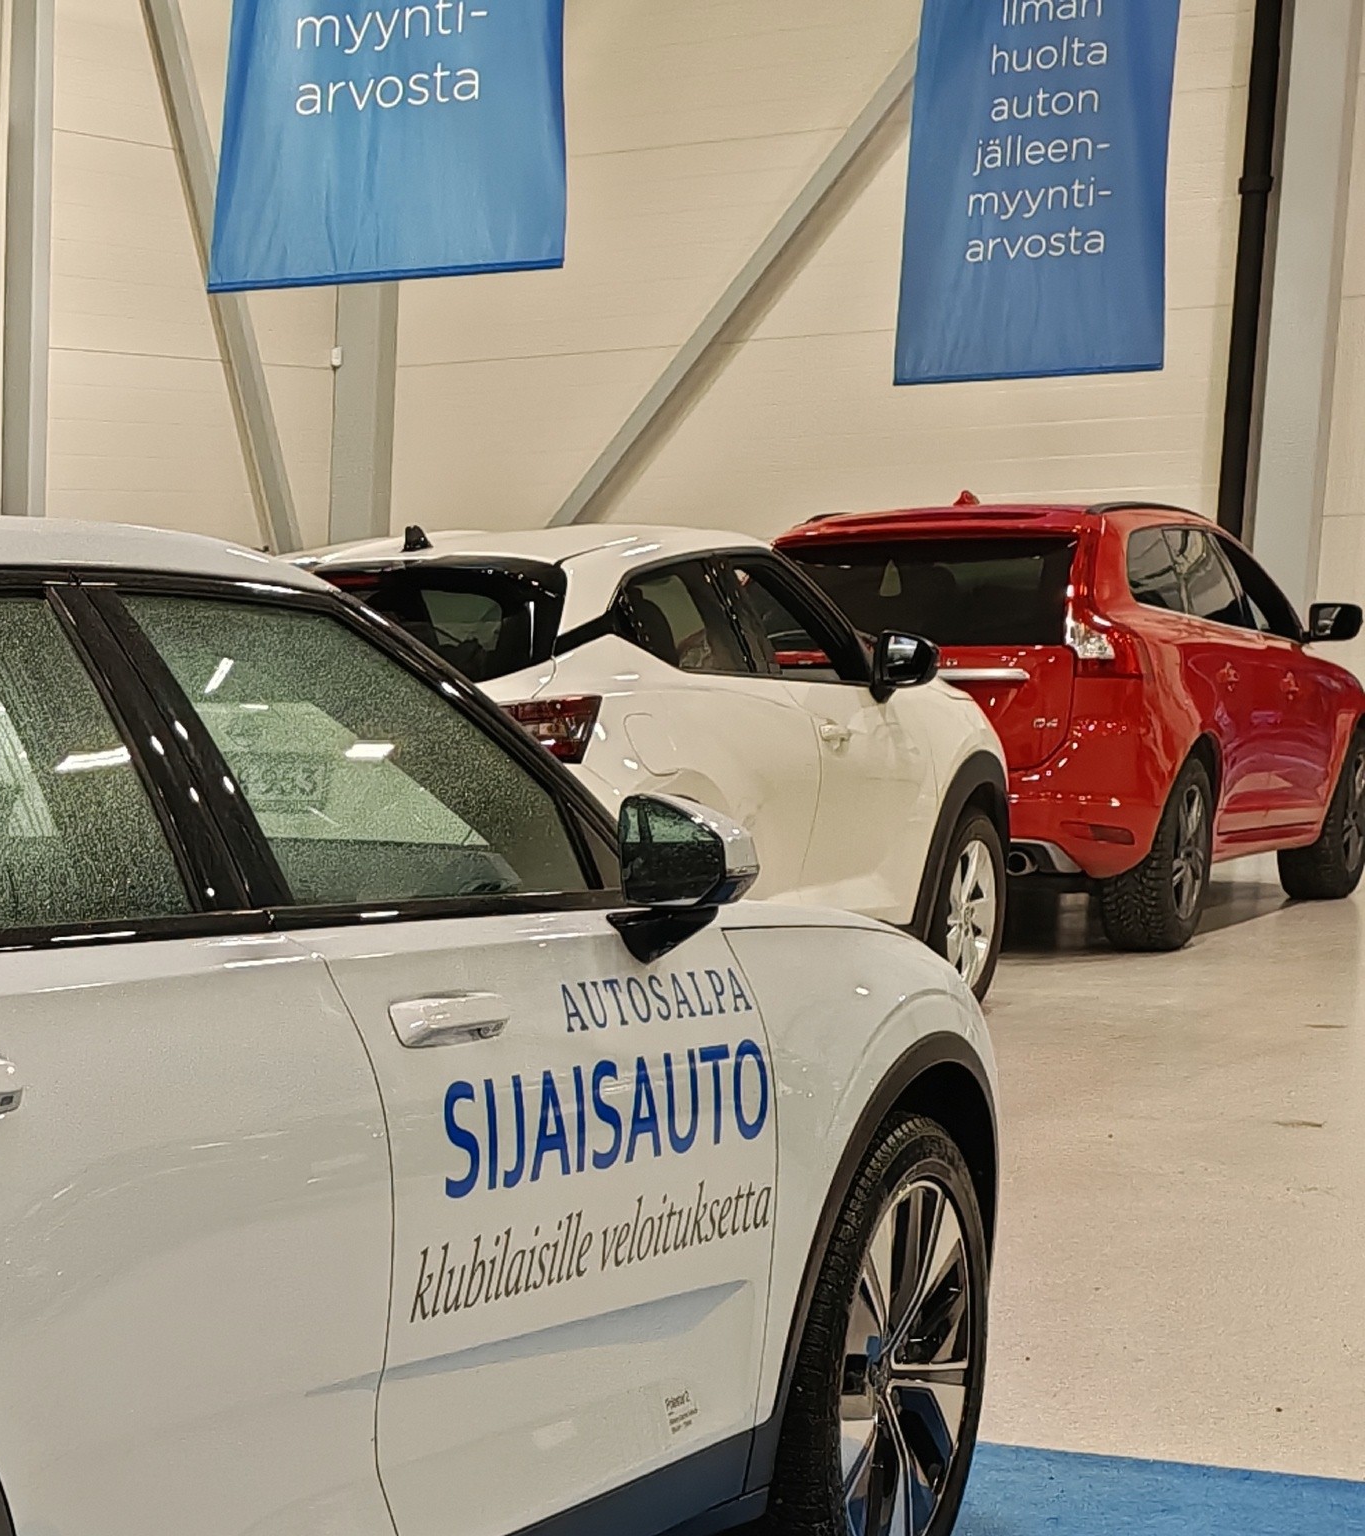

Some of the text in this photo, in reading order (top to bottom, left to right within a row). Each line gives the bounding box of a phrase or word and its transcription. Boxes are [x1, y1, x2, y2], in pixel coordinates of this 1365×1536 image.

[296, 0, 489, 54] myynti-
[1002, 0, 1102, 27] Ilman
[990, 36, 1109, 76] huolta
[295, 62, 481, 116] arvosta
[990, 87, 1100, 122] auton
[972, 135, 1111, 176] jälleen-
[967, 177, 1112, 220] myynti-
[965, 230, 1105, 262] arvosta
[560, 967, 753, 1033] AUTOSALPA
[444, 1038, 769, 1199] SIJAISAUTO
[410, 1180, 772, 1324] klubilaisille veloituksetta
